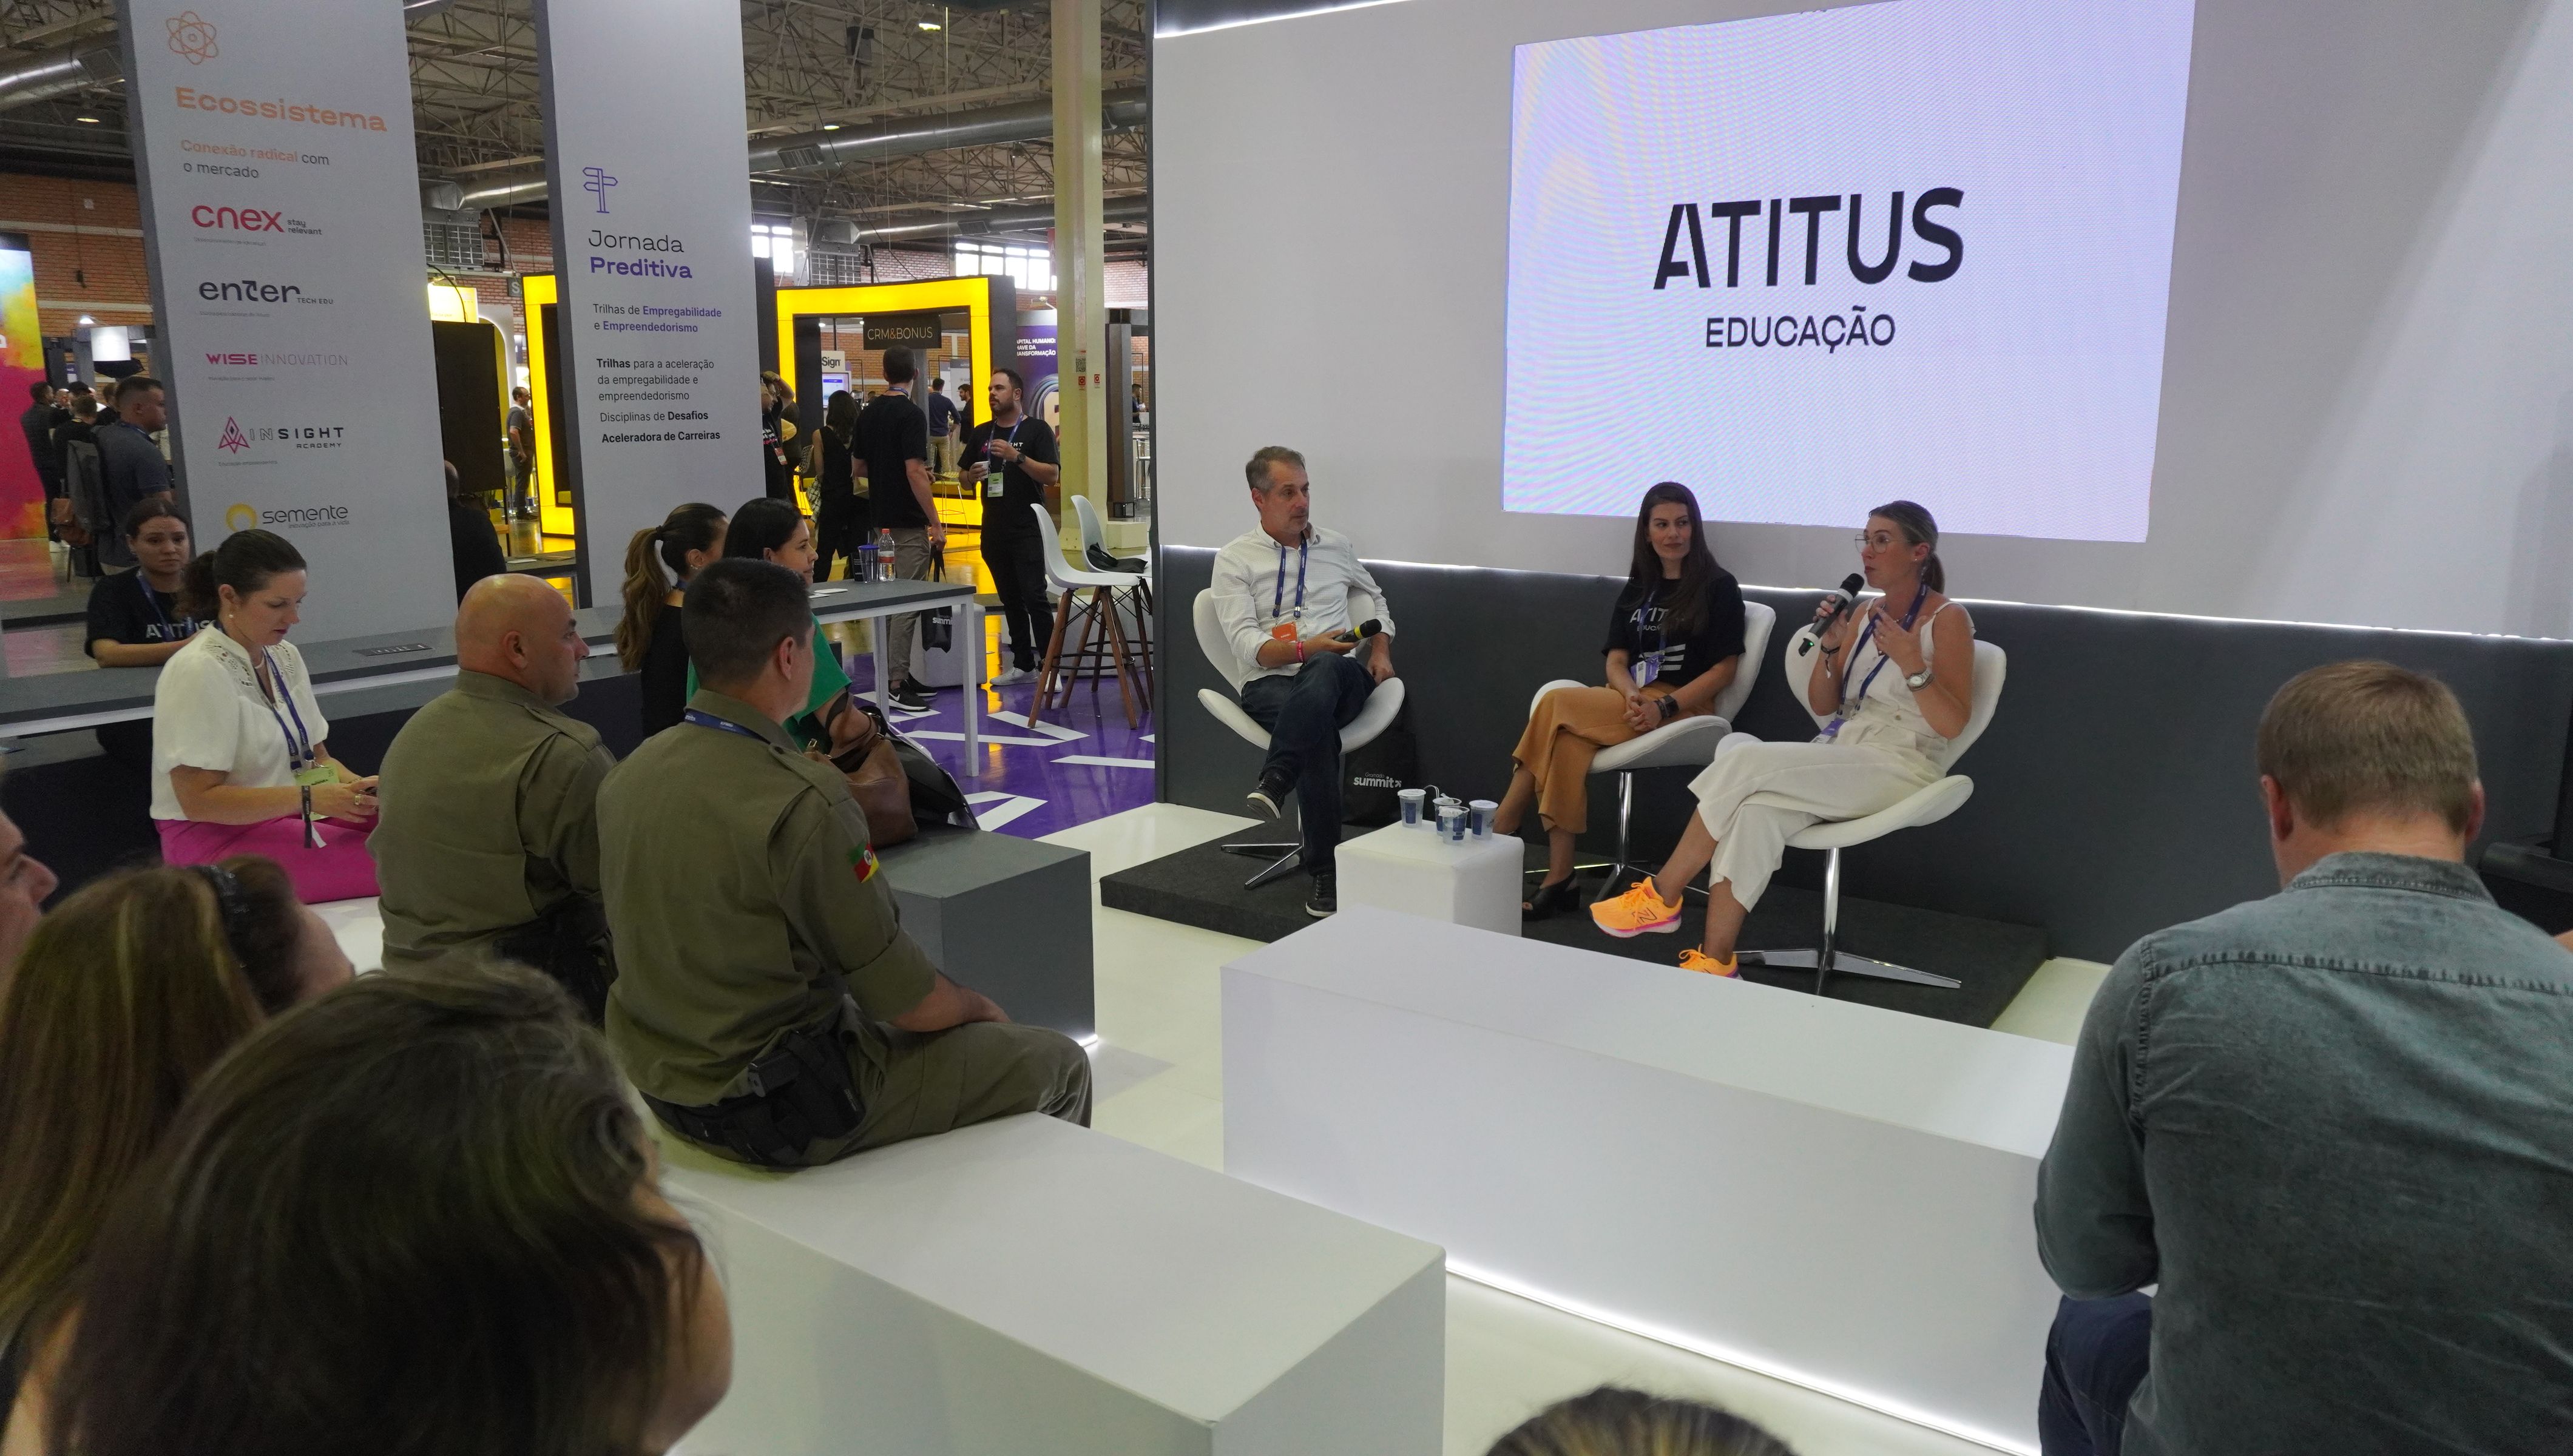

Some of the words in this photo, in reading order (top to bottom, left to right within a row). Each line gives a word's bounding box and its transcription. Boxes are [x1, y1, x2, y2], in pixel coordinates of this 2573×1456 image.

[175, 86, 388, 132] Ecossistema
[181, 140, 246, 157] Conexão
[251, 148, 298, 162] radical
[302, 154, 330, 165] com
[183, 162, 192, 172] o
[197, 162, 259, 178] mercado
[192, 205, 285, 232] cnex
[287, 218, 306, 228] stay
[288, 227, 322, 235] relevant
[1653, 187, 1964, 289] ATITUS
[589, 230, 685, 252] Jornada
[590, 257, 692, 278] Preditiva
[199, 280, 300, 303] enter
[593, 303, 625, 314] Trilhas
[628, 305, 640, 315] de
[643, 306, 722, 318] Empregabilidade
[603, 321, 698, 333] Empreendedorismo
[867, 326, 933, 340] CRM&BONUS
[1706, 305, 1896, 354] EDUCAÇÃO
[205, 354, 258, 365] WISE
[260, 354, 348, 365] INNOVATION
[597, 358, 631, 368] Trilhas
[634, 360, 654, 370] para
[665, 359, 714, 370] aceleração
[598, 375, 610, 385] da
[612, 374, 691, 386] empregabilidade
[598, 391, 689, 403] empreendedorismo
[600, 412, 651, 423] Disciplinas
[654, 412, 665, 421] de
[668, 411, 709, 420] Desafios
[249, 427, 344, 441] INSIGHT
[602, 433, 661, 443] Aceleradora
[664, 432, 675, 441] de
[678, 431, 720, 441] Carreiras
[262, 505, 348, 524] semente
[1353, 777, 1395, 788] summit
